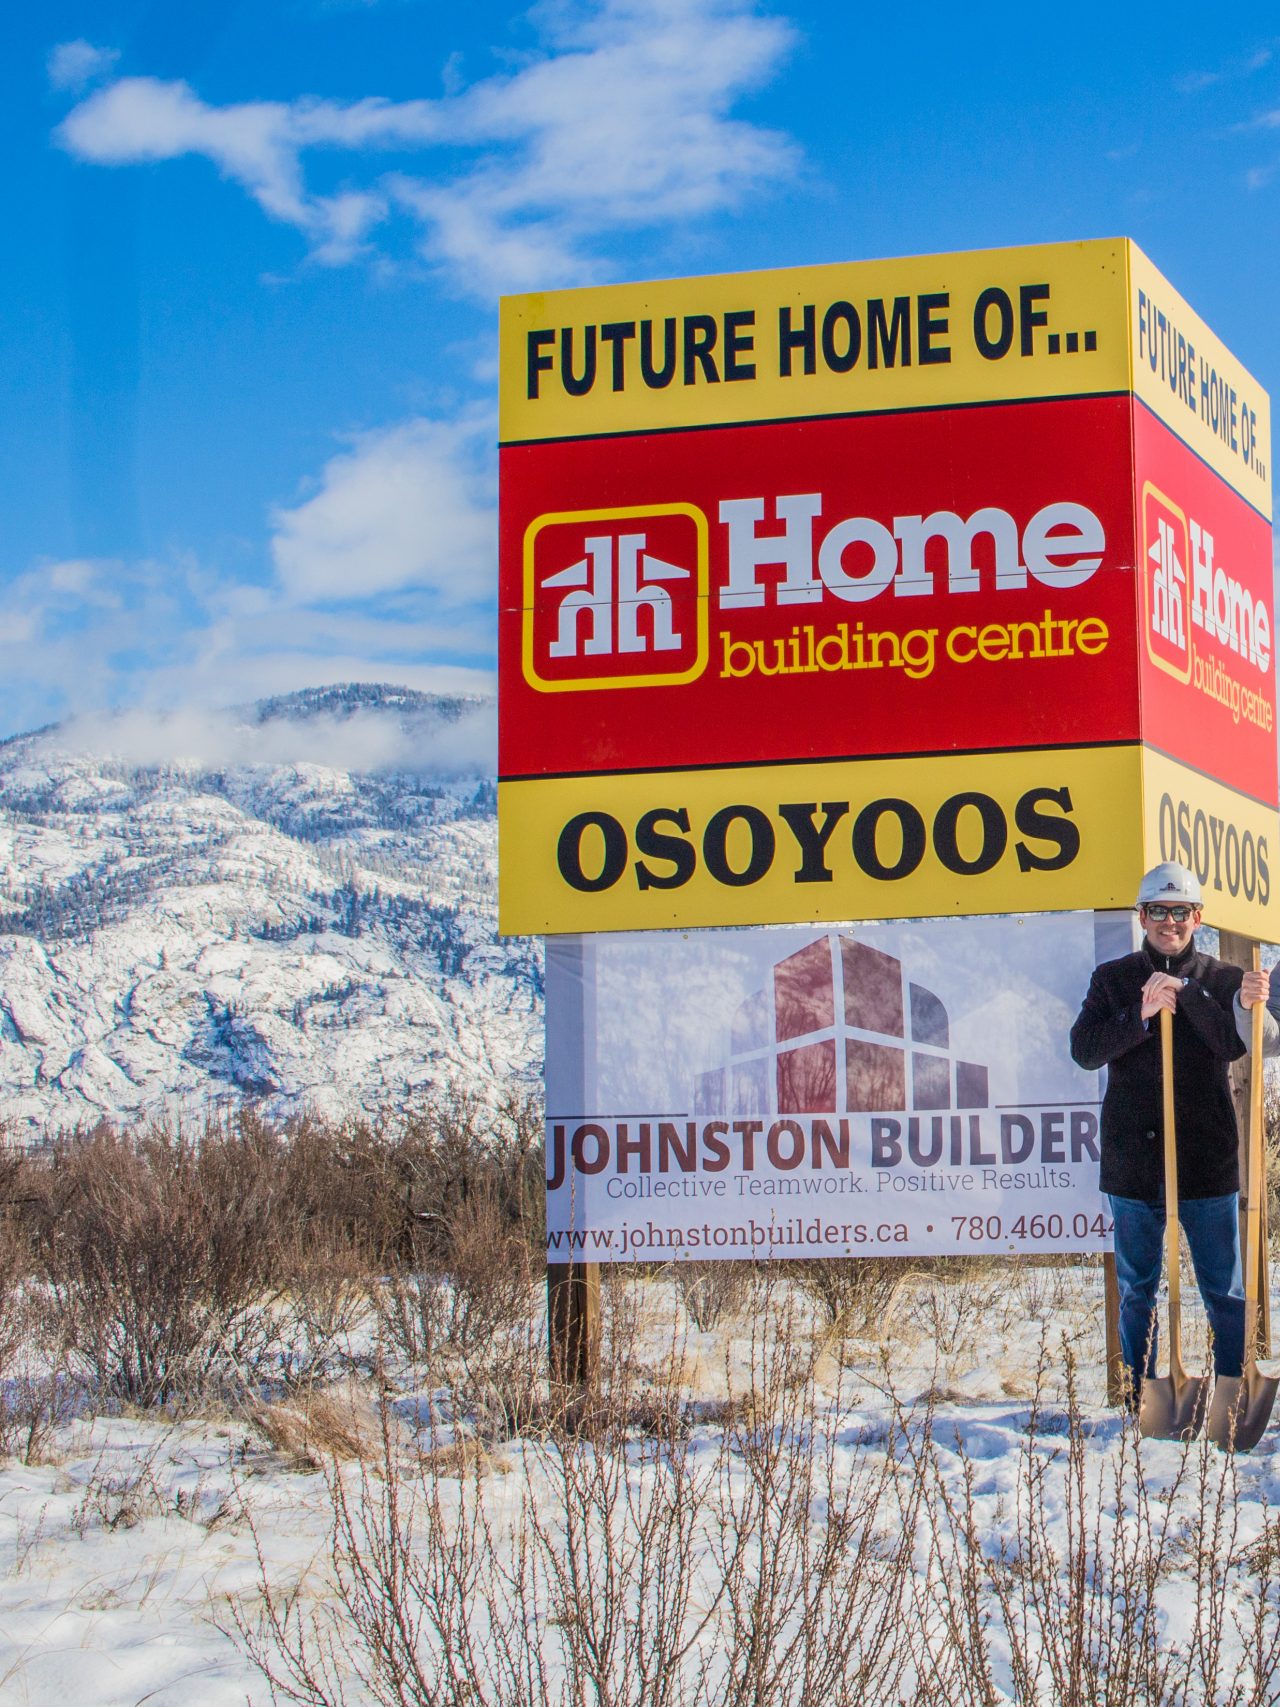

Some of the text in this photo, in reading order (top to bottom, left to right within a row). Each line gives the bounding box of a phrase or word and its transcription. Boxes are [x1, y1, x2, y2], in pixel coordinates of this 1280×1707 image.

[527, 283, 1098, 400] FUTURE HOME OF...
[1138, 288, 1266, 481] FUTURE HOME OF...
[718, 492, 1106, 610] Home
[1189, 518, 1271, 674] Home
[719, 608, 1110, 680] building centre
[1192, 643, 1273, 734] building centre
[557, 786, 1081, 892] OSOYOOS
[1159, 792, 1270, 906] OSOYOOS
[547, 1119, 850, 1190] JOHNSTON
[606, 1165, 1077, 1199] Collective Teamwork. Positive Results.
[547, 1218, 909, 1254] www.johnstonbuilders.ca
